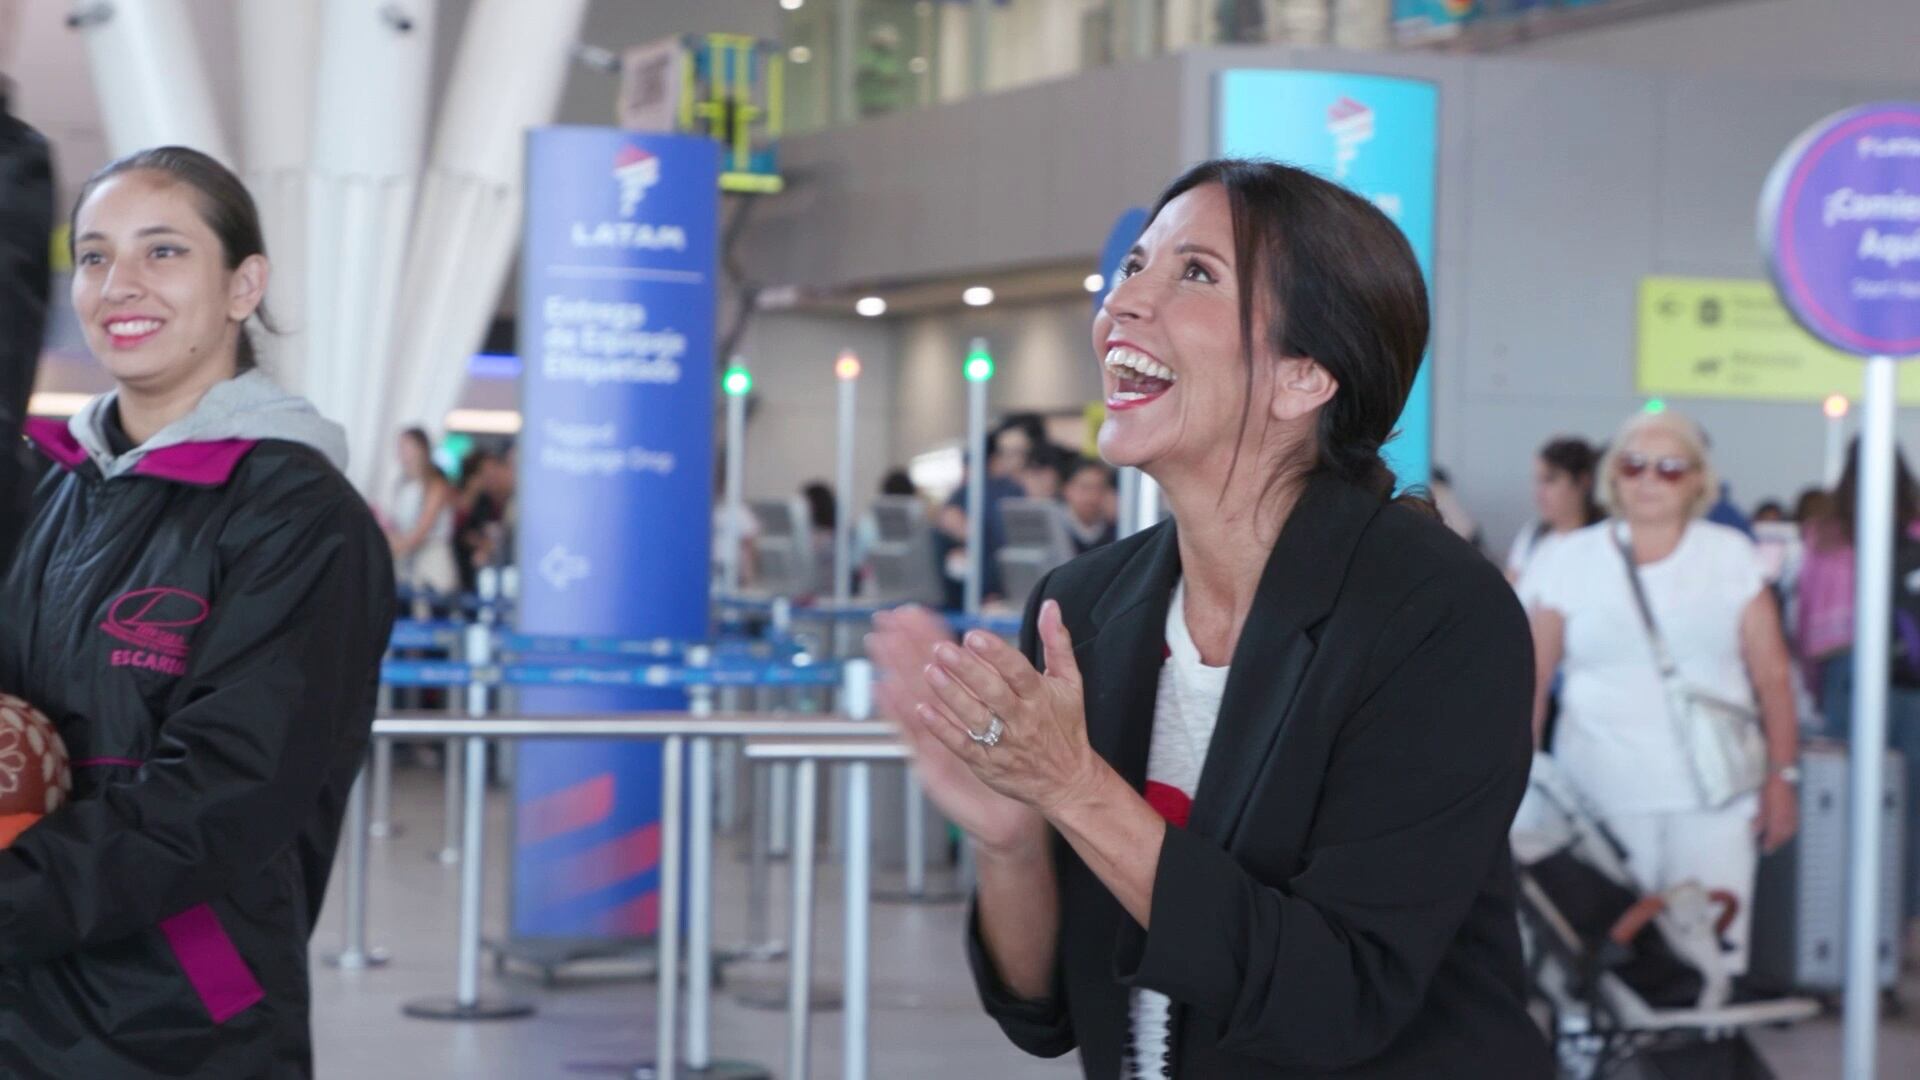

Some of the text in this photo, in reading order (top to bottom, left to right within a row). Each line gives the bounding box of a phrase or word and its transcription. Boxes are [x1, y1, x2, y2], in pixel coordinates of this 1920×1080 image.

[1824, 188, 1920, 227] ¡Comie
[571, 222, 686, 251] LATAM
[546, 296, 645, 328] Entrega
[545, 325, 686, 356] de Equipaje
[545, 352, 681, 386] Etiquetado
